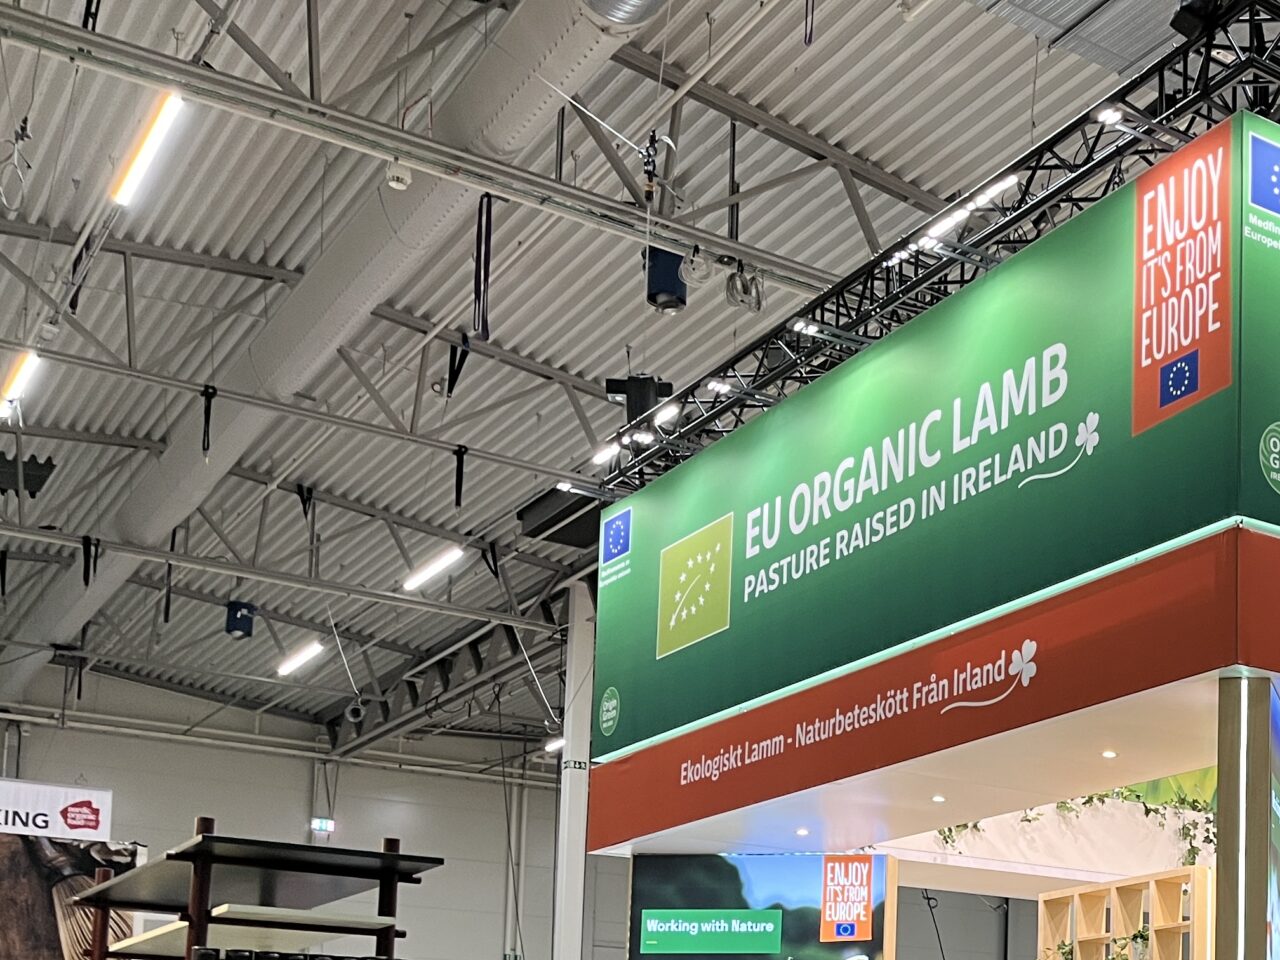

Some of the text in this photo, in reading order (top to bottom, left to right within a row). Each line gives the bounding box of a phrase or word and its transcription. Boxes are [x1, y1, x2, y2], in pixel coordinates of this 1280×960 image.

[1143, 147, 1223, 260] ENJOY
[1142, 221, 1221, 309] IT'S FROM
[1141, 272, 1221, 368] EUROPE
[746, 342, 1068, 559] EU ORGANIC LAMB
[744, 422, 1067, 603] PASTURE RAISED IN IRELAND
[680, 745, 741, 785] Ekologiskt
[745, 733, 784, 765] Lamm
[796, 688, 909, 749] Naturbeteskött
[912, 673, 948, 710] Från
[953, 650, 1006, 697] Irland
[825, 902, 867, 922] EUROPE
[826, 886, 868, 903] IT'S FROM
[827, 862, 869, 886] ENJOY
[646, 919, 774, 935] Working with Nature
